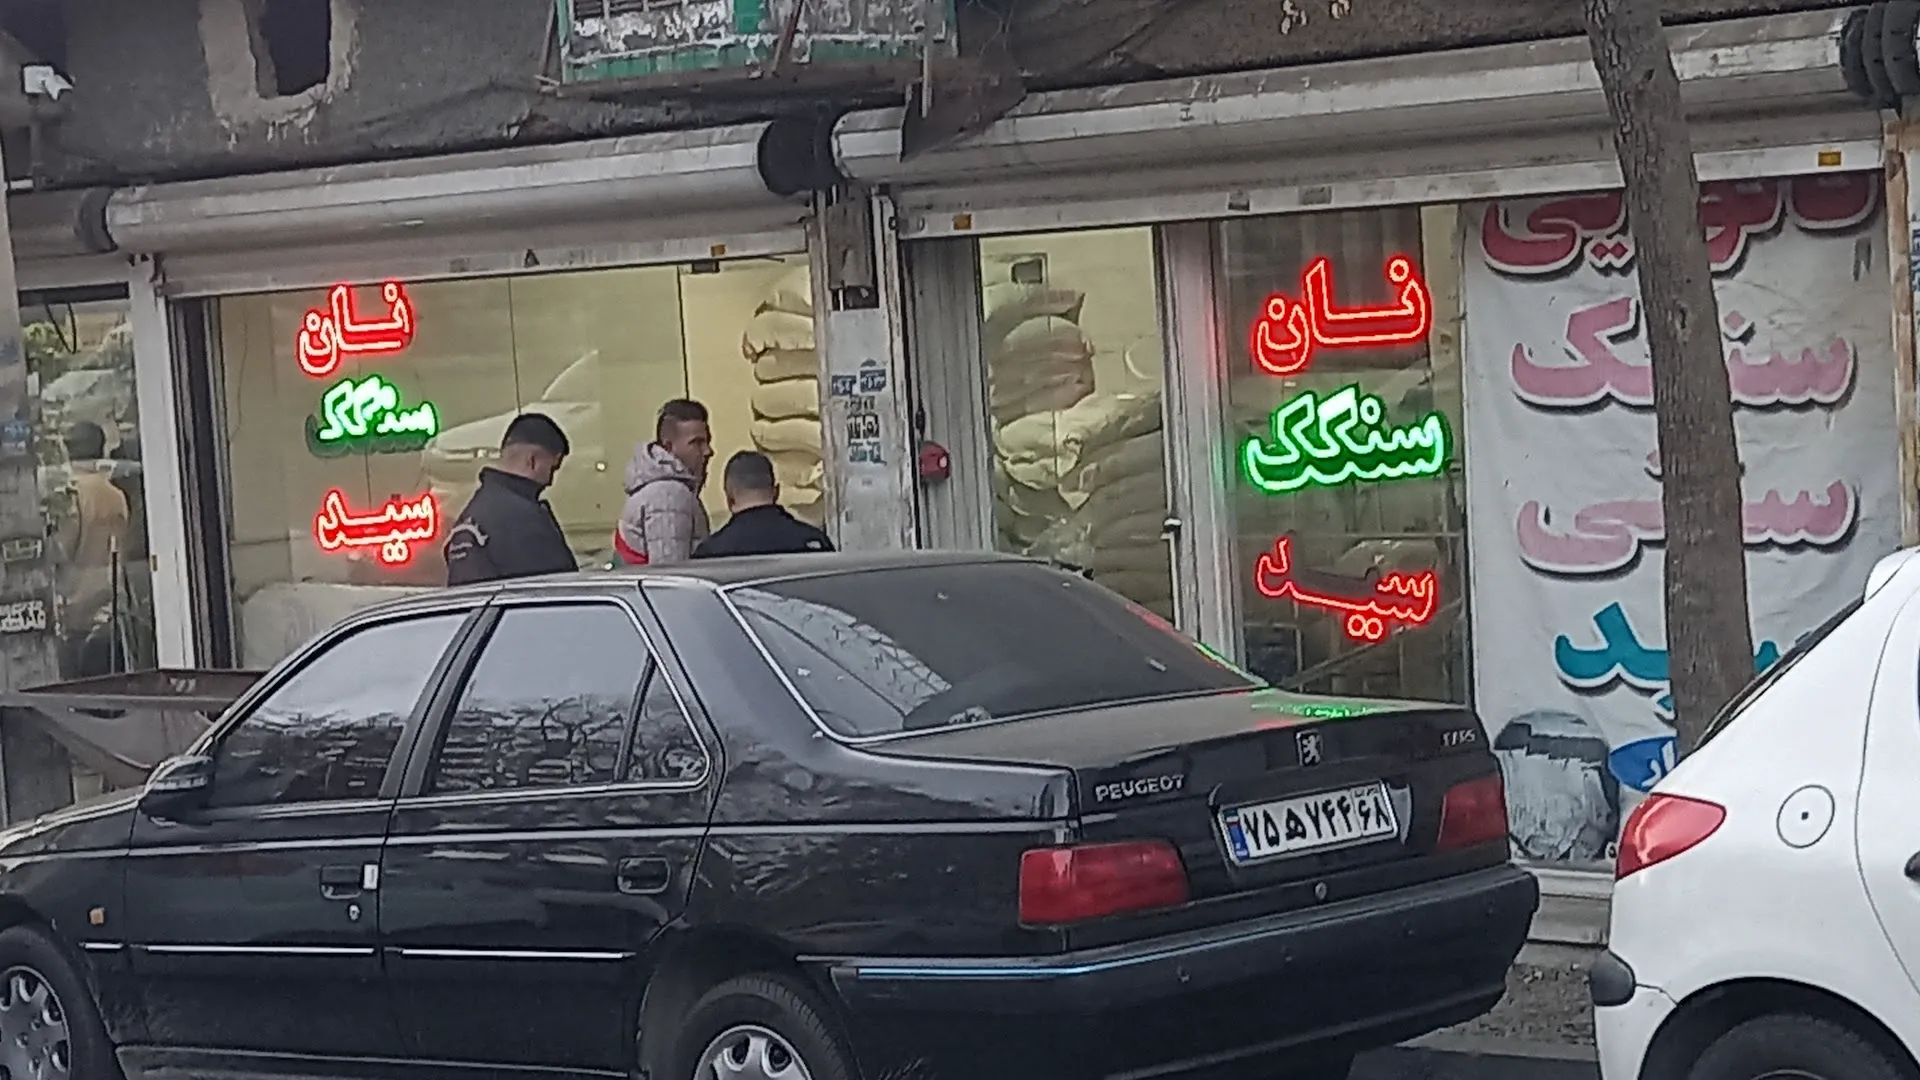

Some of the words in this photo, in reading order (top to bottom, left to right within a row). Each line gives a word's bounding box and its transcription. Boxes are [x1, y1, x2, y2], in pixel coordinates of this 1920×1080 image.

[299, 282, 412, 375] نان
[1255, 258, 1430, 374] نان
[1245, 383, 1447, 492] سنگک
[1095, 774, 1185, 803] PEUGEOT
